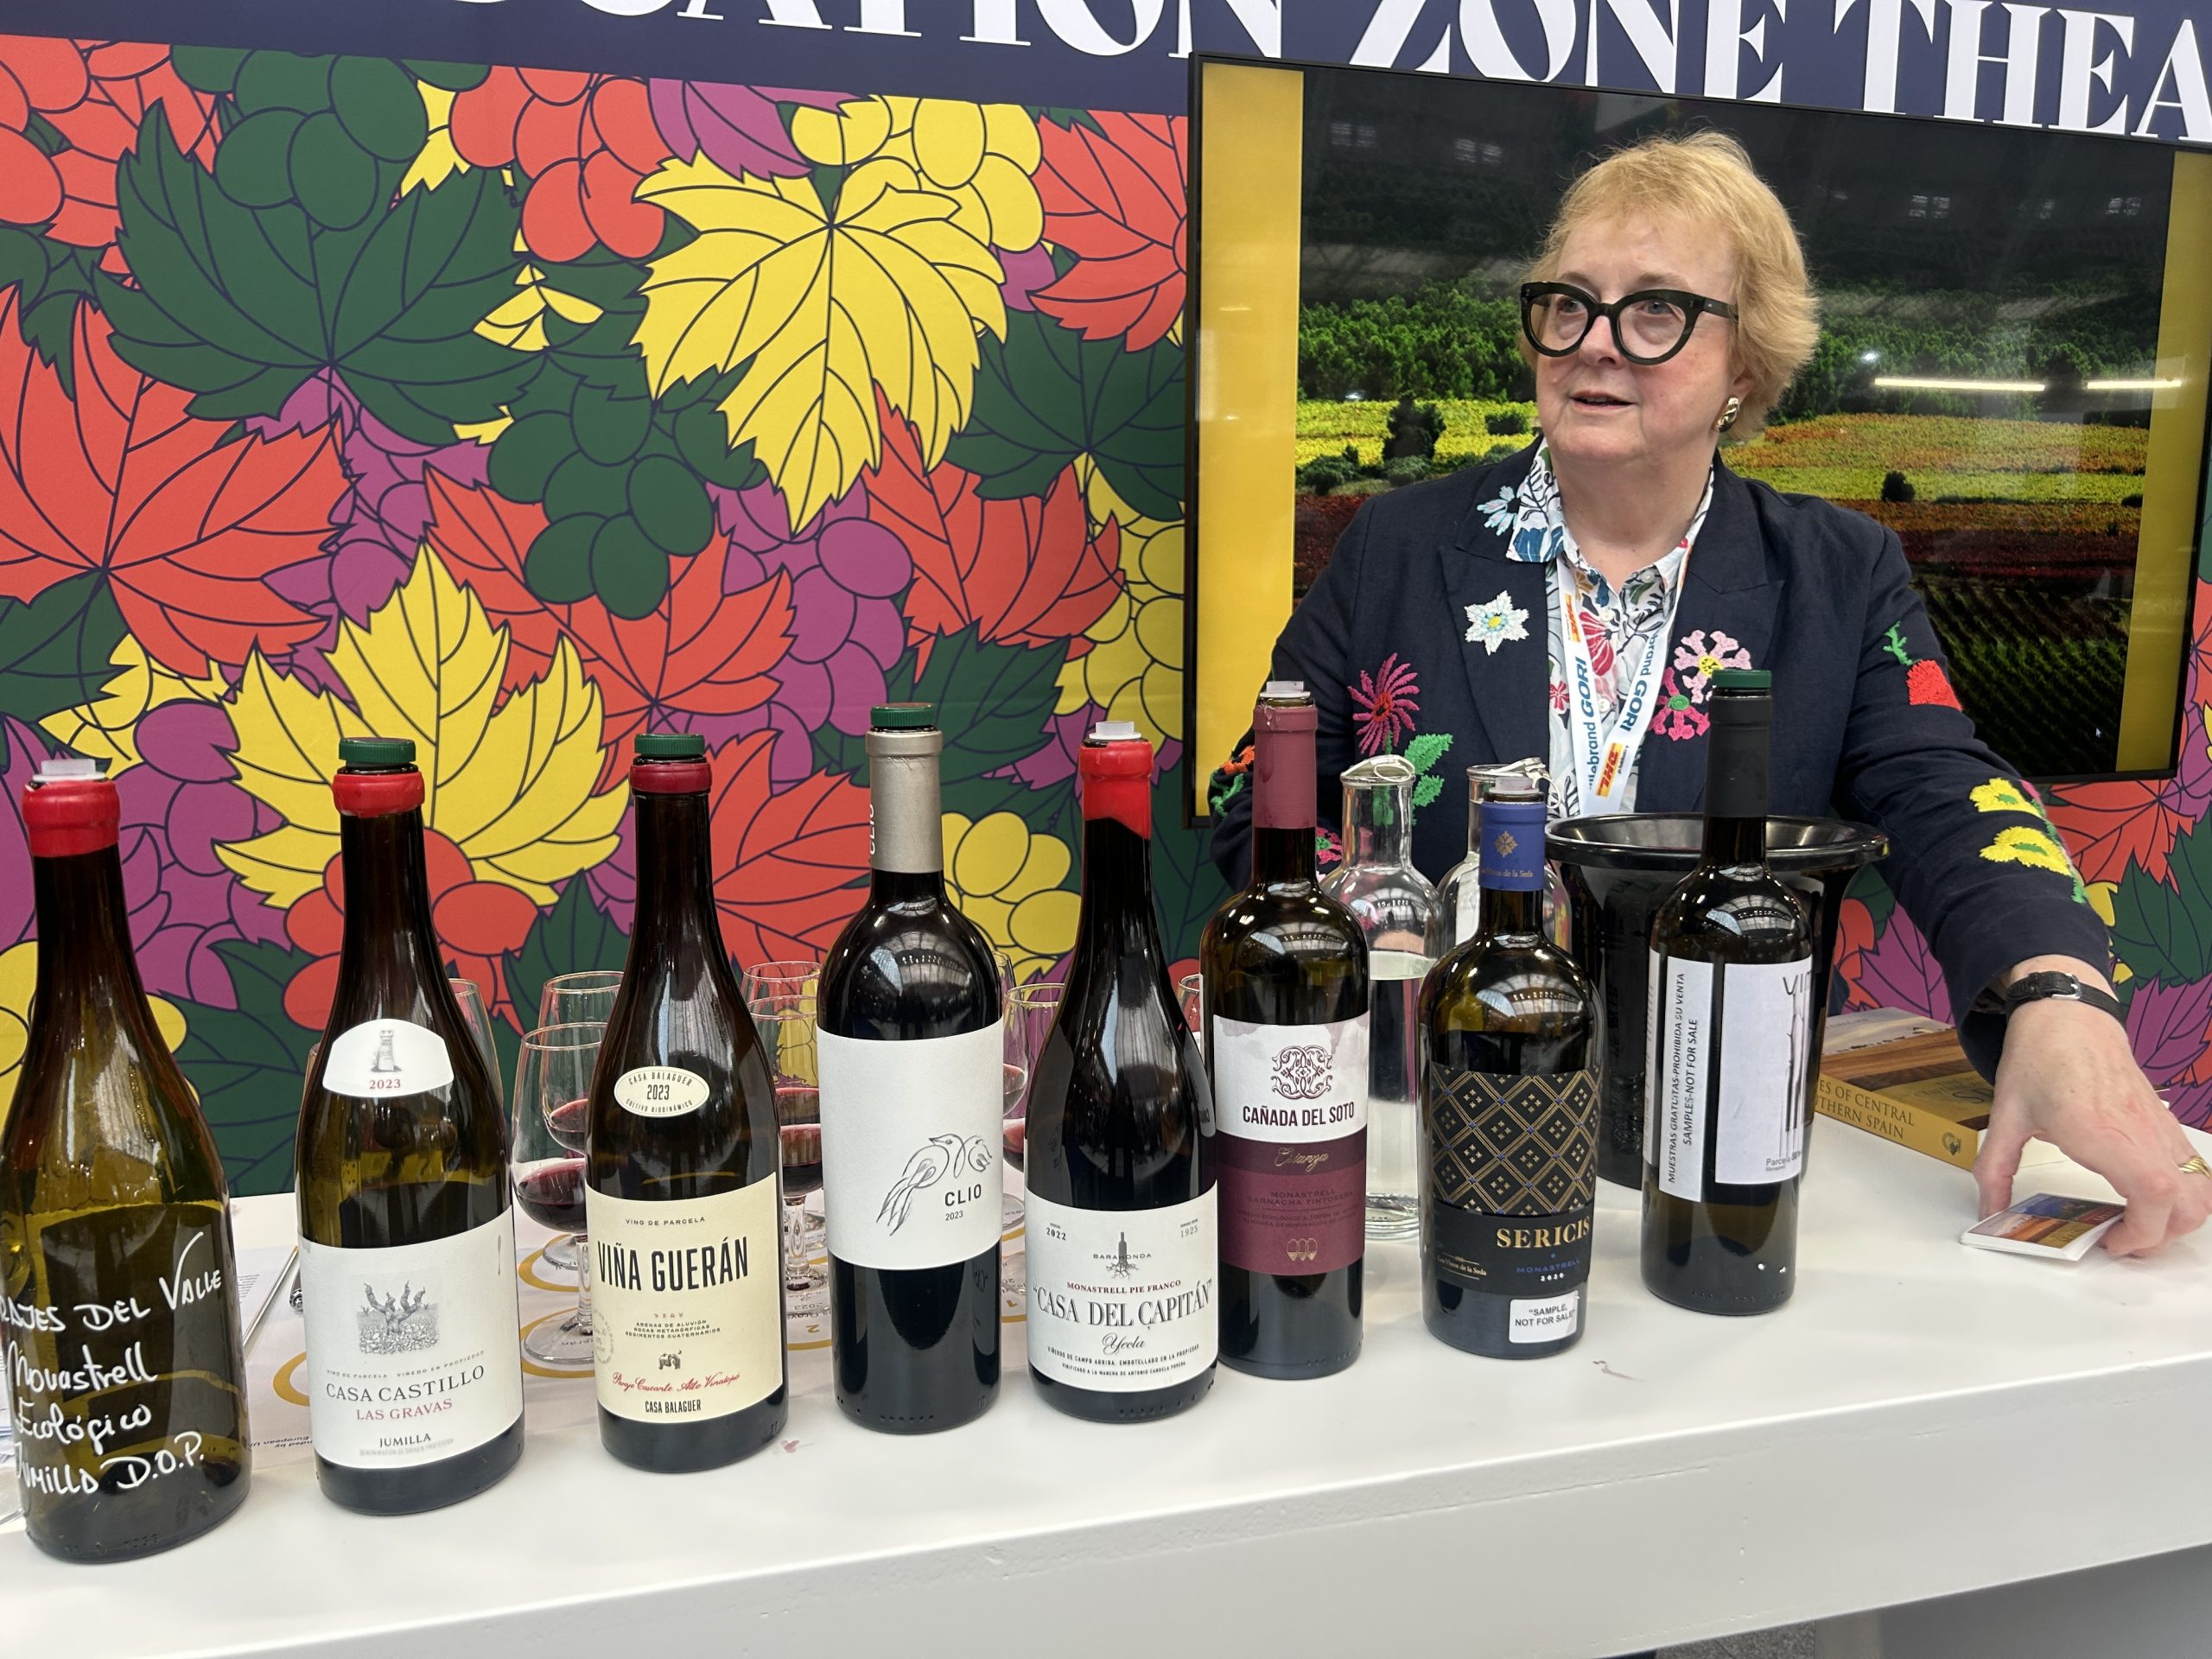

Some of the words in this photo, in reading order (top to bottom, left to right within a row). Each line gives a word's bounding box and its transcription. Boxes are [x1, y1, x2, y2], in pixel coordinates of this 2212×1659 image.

[1349, 0, 1783, 103] ZONE
[1575, 657, 1594, 718] GORI
[1620, 680, 1648, 732] GORI
[1600, 752, 1618, 788] DHL
[1675, 973, 1685, 1005] VENTA
[1675, 1007, 1683, 1021] SU
[1688, 1018, 1698, 1045] SALE
[1686, 1047, 1697, 1069] FOR
[369, 1078, 402, 1090] 2023
[628, 1073, 647, 1085] CASA
[652, 1071, 693, 1086] BALAGUER
[647, 1084, 670, 1100] 2023
[626, 1098, 648, 1112] CULTIVO
[1243, 1105, 1298, 1127] CAÑADA
[1302, 1108, 1325, 1126] DEL
[1329, 1102, 1354, 1123] SOTO
[1682, 1070, 1695, 1145] SAMPLES-NOT
[1834, 1085, 1852, 1103] OF
[1854, 1094, 1914, 1127] CENTRAL
[1866, 1115, 1904, 1140] SPAIN
[1668, 1133, 1676, 1184] MUESTRAS
[944, 1184, 982, 1207] CLIO
[1271, 1188, 1335, 1198] MONASTRELL
[664, 1217, 706, 1225] PARCELA
[945, 1211, 964, 1221] 2023
[1046, 1227, 1066, 1241] 2022
[1180, 1224, 1198, 1237] 1925
[1496, 1216, 1590, 1249] SERICIS
[597, 1240, 642, 1291] VIÑA
[651, 1236, 748, 1292] GUERÁN
[1516, 1260, 1580, 1273] MONASTRELL
[1067, 1281, 1127, 1294] MONASTRELL
[1147, 1280, 1181, 1292] FRANCO
[73, 1297, 151, 1332] DEL
[1087, 1300, 1134, 1326] DEL
[1102, 1332, 1146, 1356] Yecla
[444, 1350, 484, 1368] PROPIEDAD
[327, 1383, 372, 1402] CASA
[378, 1365, 484, 1402] CASTILLO
[356, 1409, 384, 1420] LAS
[390, 1398, 452, 1420] GRAVAS
[645, 1401, 663, 1414] CASA
[664, 1399, 702, 1414] BALAGUER
[380, 1433, 431, 1447] JUMILLA
[99, 1431, 205, 1490] D.O.P.
